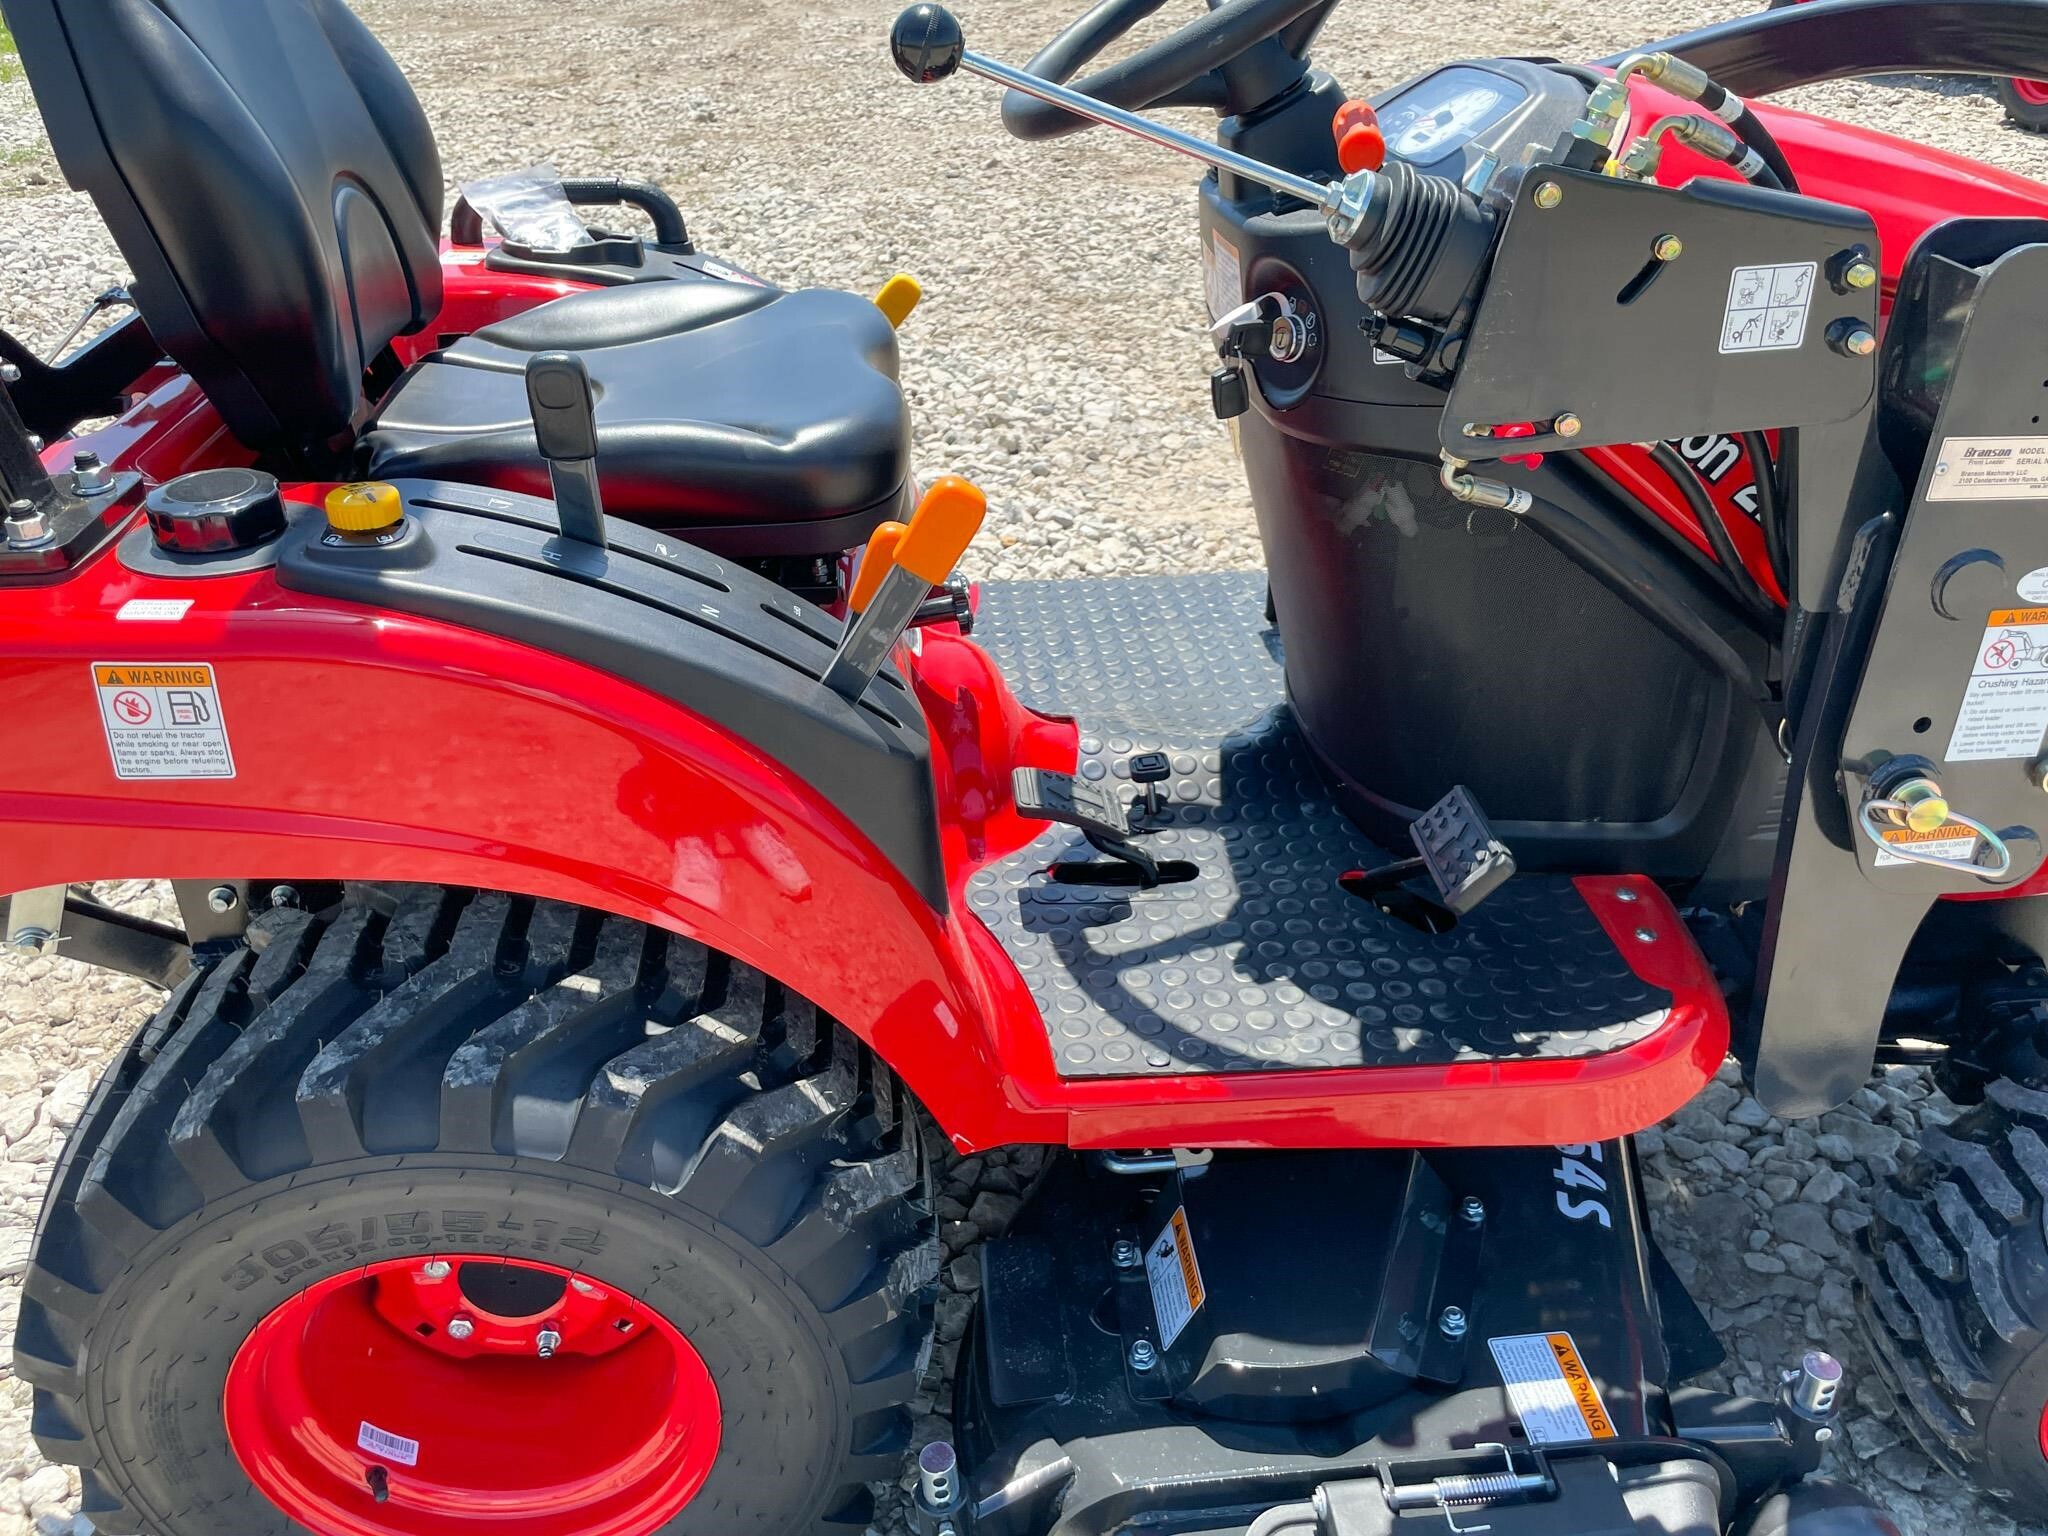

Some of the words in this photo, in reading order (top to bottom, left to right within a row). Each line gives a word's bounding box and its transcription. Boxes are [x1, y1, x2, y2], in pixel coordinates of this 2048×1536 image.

[1680, 434, 1740, 481] on
[1964, 447, 2012, 458] Branson
[2018, 447, 2046, 455] MODEL
[128, 670, 205, 684] WARNING
[1977, 678, 2018, 689] Crushing
[113, 731, 124, 739] Do
[127, 731, 139, 739] not
[142, 731, 164, 739] refuel
[166, 731, 178, 739] the
[180, 731, 205, 739] tractor
[116, 740, 135, 748] while
[137, 740, 169, 750] smoking
[182, 741, 199, 749] near
[202, 741, 222, 750] open
[117, 749, 137, 757] flame
[150, 749, 178, 759] sparks.
[180, 749, 205, 759] Always
[208, 749, 224, 757] stop
[119, 757, 132, 765] the
[135, 759, 161, 767] engine
[164, 757, 189, 765] before
[191, 757, 225, 766] refueling
[1179, 1237, 1200, 1300] WARNING
[1563, 1359, 1606, 1431] WARNING
